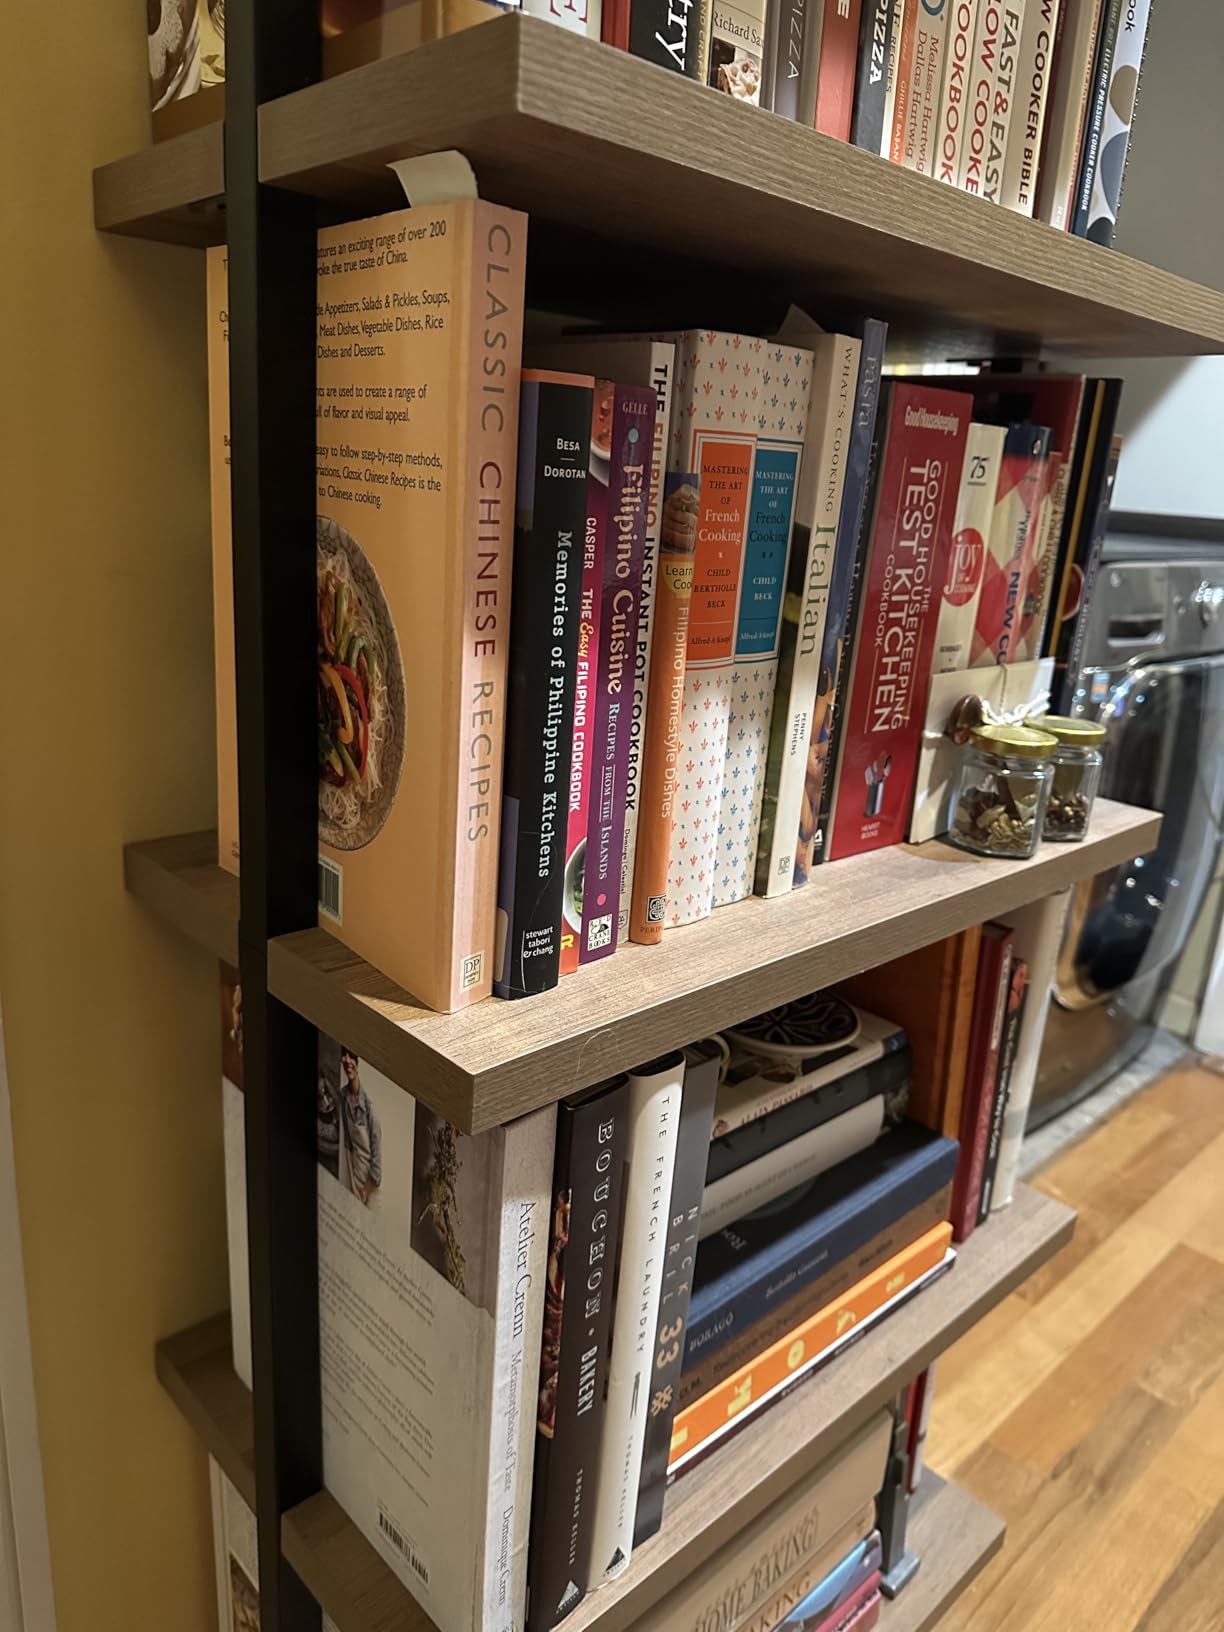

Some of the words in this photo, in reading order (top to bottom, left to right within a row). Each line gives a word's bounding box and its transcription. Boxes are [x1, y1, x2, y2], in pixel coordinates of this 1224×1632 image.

[713, 11, 750, 41] Richard
[886, 36, 897, 94] RECIPES
[913, 28, 928, 88] Dallas
[924, 36, 940, 105] Melissa
[998, 8, 1020, 94] FAST
[1099, 47, 1112, 88] ELECTRIC
[993, 90, 1009, 116] &
[1026, 30, 1050, 140] COOKER
[904, 90, 922, 158] Hartwig
[1092, 88, 1106, 131] PRESSURE
[916, 106, 932, 173] Hartwig
[983, 119, 1006, 204] EASY
[1087, 133, 1099, 166] COOKER
[1018, 147, 1034, 206] BIBLE
[1080, 167, 1094, 212] COOKBOOK
[338, 243, 347, 255] an
[348, 236, 374, 253] exciting
[375, 233, 396, 250] range
[397, 227, 406, 244] of
[408, 228, 427, 242] over
[429, 220, 447, 238] 200
[332, 260, 343, 275] the
[344, 260, 357, 273] true
[359, 257, 375, 270] taste
[377, 251, 385, 267] of
[386, 248, 409, 266] China.
[319, 324, 335, 337] Meat
[337, 321, 361, 336] Dishes,
[361, 318, 394, 338] Vegetable
[395, 316, 423, 332] Dishes,
[425, 314, 444, 330] Rice
[325, 300, 361, 320] Appetizers,
[362, 295, 383, 312] Salads
[384, 295, 391, 309] &
[393, 291, 420, 308] Pickles,
[422, 289, 450, 309] Soups,
[480, 222, 512, 434] CLASSIC
[317, 345, 339, 359] Dishes
[340, 343, 352, 358] and
[354, 343, 387, 358] Desserts.
[326, 387, 337, 398] are
[338, 384, 354, 398] used
[355, 385, 364, 398] to
[365, 386, 387, 398] create
[388, 387, 393, 398] a
[395, 387, 416, 403] range
[418, 384, 428, 399] of
[653, 364, 669, 413] THE
[837, 347, 853, 420] WHAT'S
[323, 405, 332, 418] of
[332, 405, 350, 418] flavor
[351, 406, 364, 419] and
[365, 406, 384, 421] visual
[622, 402, 649, 416] GELLE
[904, 404, 921, 428] Good
[919, 406, 961, 437] Housekeeping
[330, 445, 339, 457] to
[340, 444, 360, 460] follow
[361, 448, 404, 467] step-by-step
[405, 451, 443, 470] methods,
[556, 437, 581, 451] BESA
[342, 465, 362, 482] Classic
[364, 468, 389, 485] Chinese
[390, 471, 416, 491] Recipes
[418, 476, 425, 489] is
[427, 476, 442, 493] the
[543, 464, 587, 480] DOROTAN
[702, 464, 749, 476] MASTERING
[708, 480, 727, 490] THE
[728, 482, 743, 491] ART
[755, 470, 794, 481] MASTERING
[760, 485, 775, 494] THE
[776, 486, 789, 495] ART
[824, 426, 844, 514] COOKING
[969, 455, 990, 480] 75
[319, 485, 326, 497] to
[327, 484, 353, 502] Chinese
[354, 490, 383, 510] cooking.
[705, 508, 741, 523] French
[720, 496, 731, 506] OF
[755, 512, 785, 526] French
[768, 499, 778, 509] OF
[899, 458, 930, 556] TEST
[920, 459, 943, 539] GOOD
[583, 517, 598, 570] CASPER
[612, 463, 645, 579] Filipino
[698, 529, 742, 546] Cooking
[749, 529, 787, 544] Cooking
[473, 460, 502, 659] CHINESE
[706, 568, 731, 578] CHILD
[752, 576, 777, 586] CHILD
[552, 529, 573, 637] Memories
[581, 588, 594, 619] THE
[636, 537, 655, 633] INSTANT
[706, 600, 727, 609] BECK
[753, 592, 774, 602] BECK
[800, 524, 836, 656] Italian
[873, 553, 896, 647] COOKBOOK
[919, 584, 932, 613] THE
[1002, 571, 1021, 629] NEW
[550, 646, 566, 669] of
[577, 621, 595, 658] Easy
[607, 589, 635, 696] Cuisine
[634, 640, 648, 682] POT
[671, 607, 689, 670] Filipino
[871, 566, 915, 733] KITCHEN
[890, 546, 930, 731] HOUSEKEEPING
[573, 661, 590, 727] FILIPINO
[542, 675, 566, 784] Philippine
[605, 702, 621, 762] RECIPES
[662, 675, 685, 763] Homestyle
[790, 712, 801, 757] STEPHENS
[466, 680, 495, 844] RECIPES
[568, 731, 585, 813] COOKBOOK
[624, 689, 644, 811] COOKBOOK
[602, 765, 613, 797] FROM
[661, 767, 678, 819] Dishes
[601, 798, 612, 822] THE
[537, 791, 558, 878] Kitchens
[598, 824, 613, 881] ISLANDS
[525, 925, 554, 939] stewart
[528, 936, 551, 948] tabori
[532, 944, 554, 958] chang
[465, 958, 480, 974] DP
[658, 1095, 671, 1139] THE
[584, 1116, 616, 1320] BOUCHON
[647, 1155, 665, 1242] FRENCH
[516, 1201, 537, 1272] Atelier
[677, 1205, 700, 1297] NICK
[663, 1213, 685, 1306] BRIL
[513, 1273, 533, 1339] Crenn
[636, 1257, 654, 1353] LAUNDRY
[655, 1316, 683, 1370] 33
[503, 1349, 522, 1448] Metamorphosis
[576, 1344, 599, 1417] BAKERY
[505, 1447, 518, 1460] of
[571, 1467, 584, 1519] THOMAS
[496, 1504, 515, 1563] Dominique
[498, 1566, 512, 1607] Crenn
